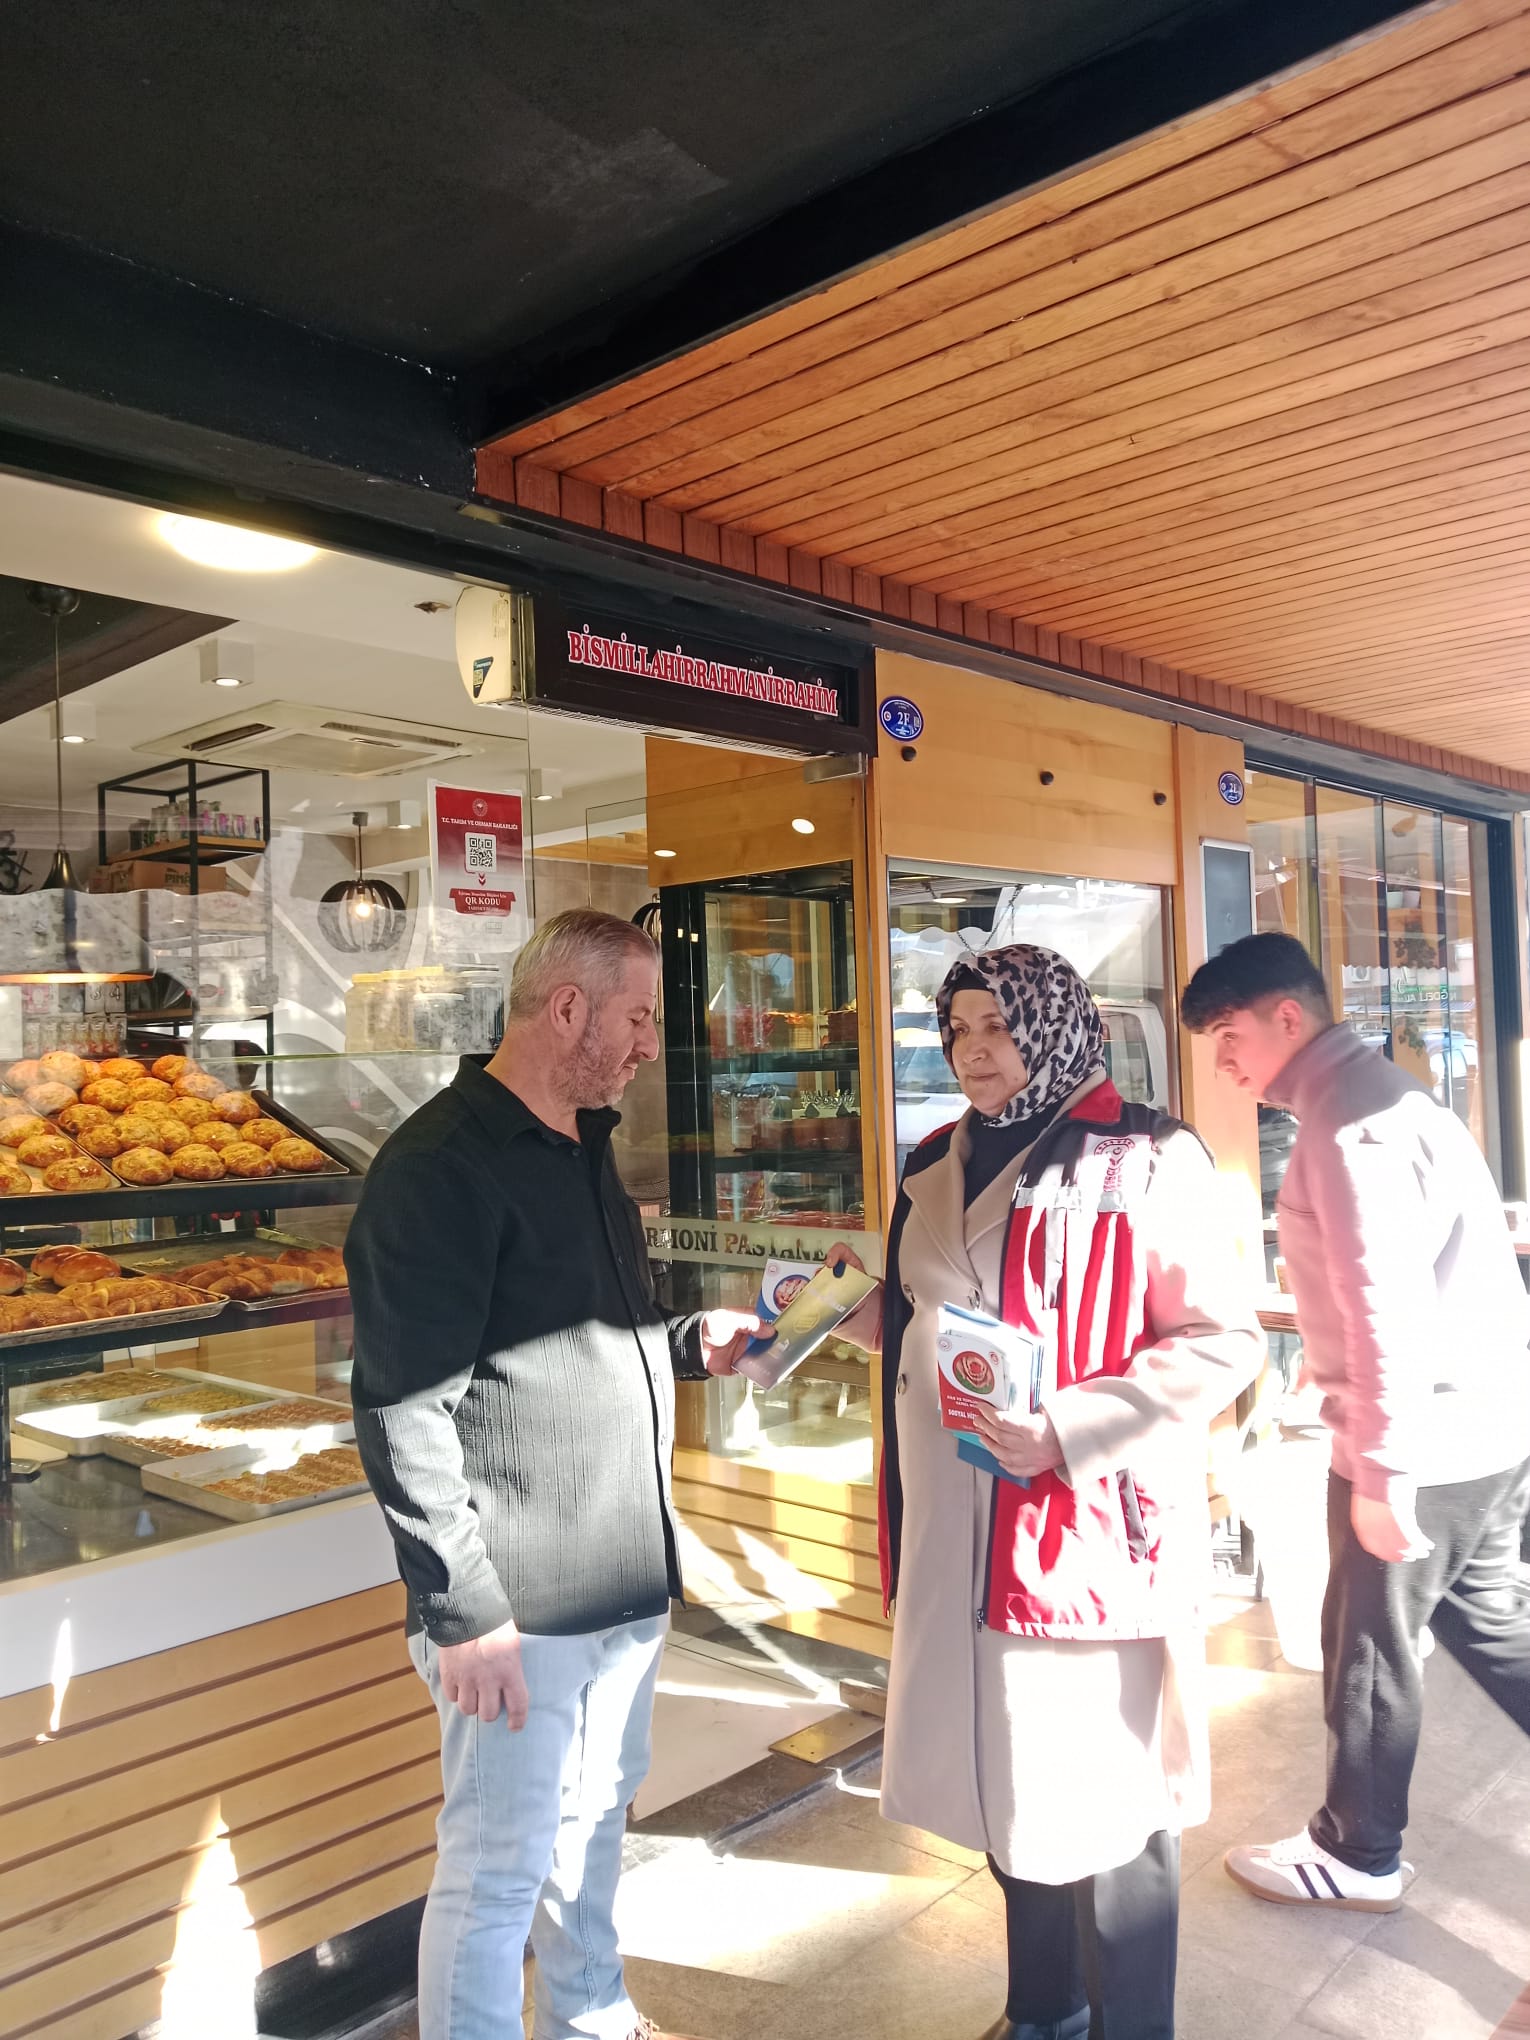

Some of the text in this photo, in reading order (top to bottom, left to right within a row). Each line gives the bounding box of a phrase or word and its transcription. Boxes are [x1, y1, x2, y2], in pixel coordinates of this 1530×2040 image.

[567, 623, 839, 717] BİSMİLLAHİRRAHMANİRRAHİM
[465, 896, 501, 906] QR KODU
[724, 1232, 831, 1261] PASTANE
